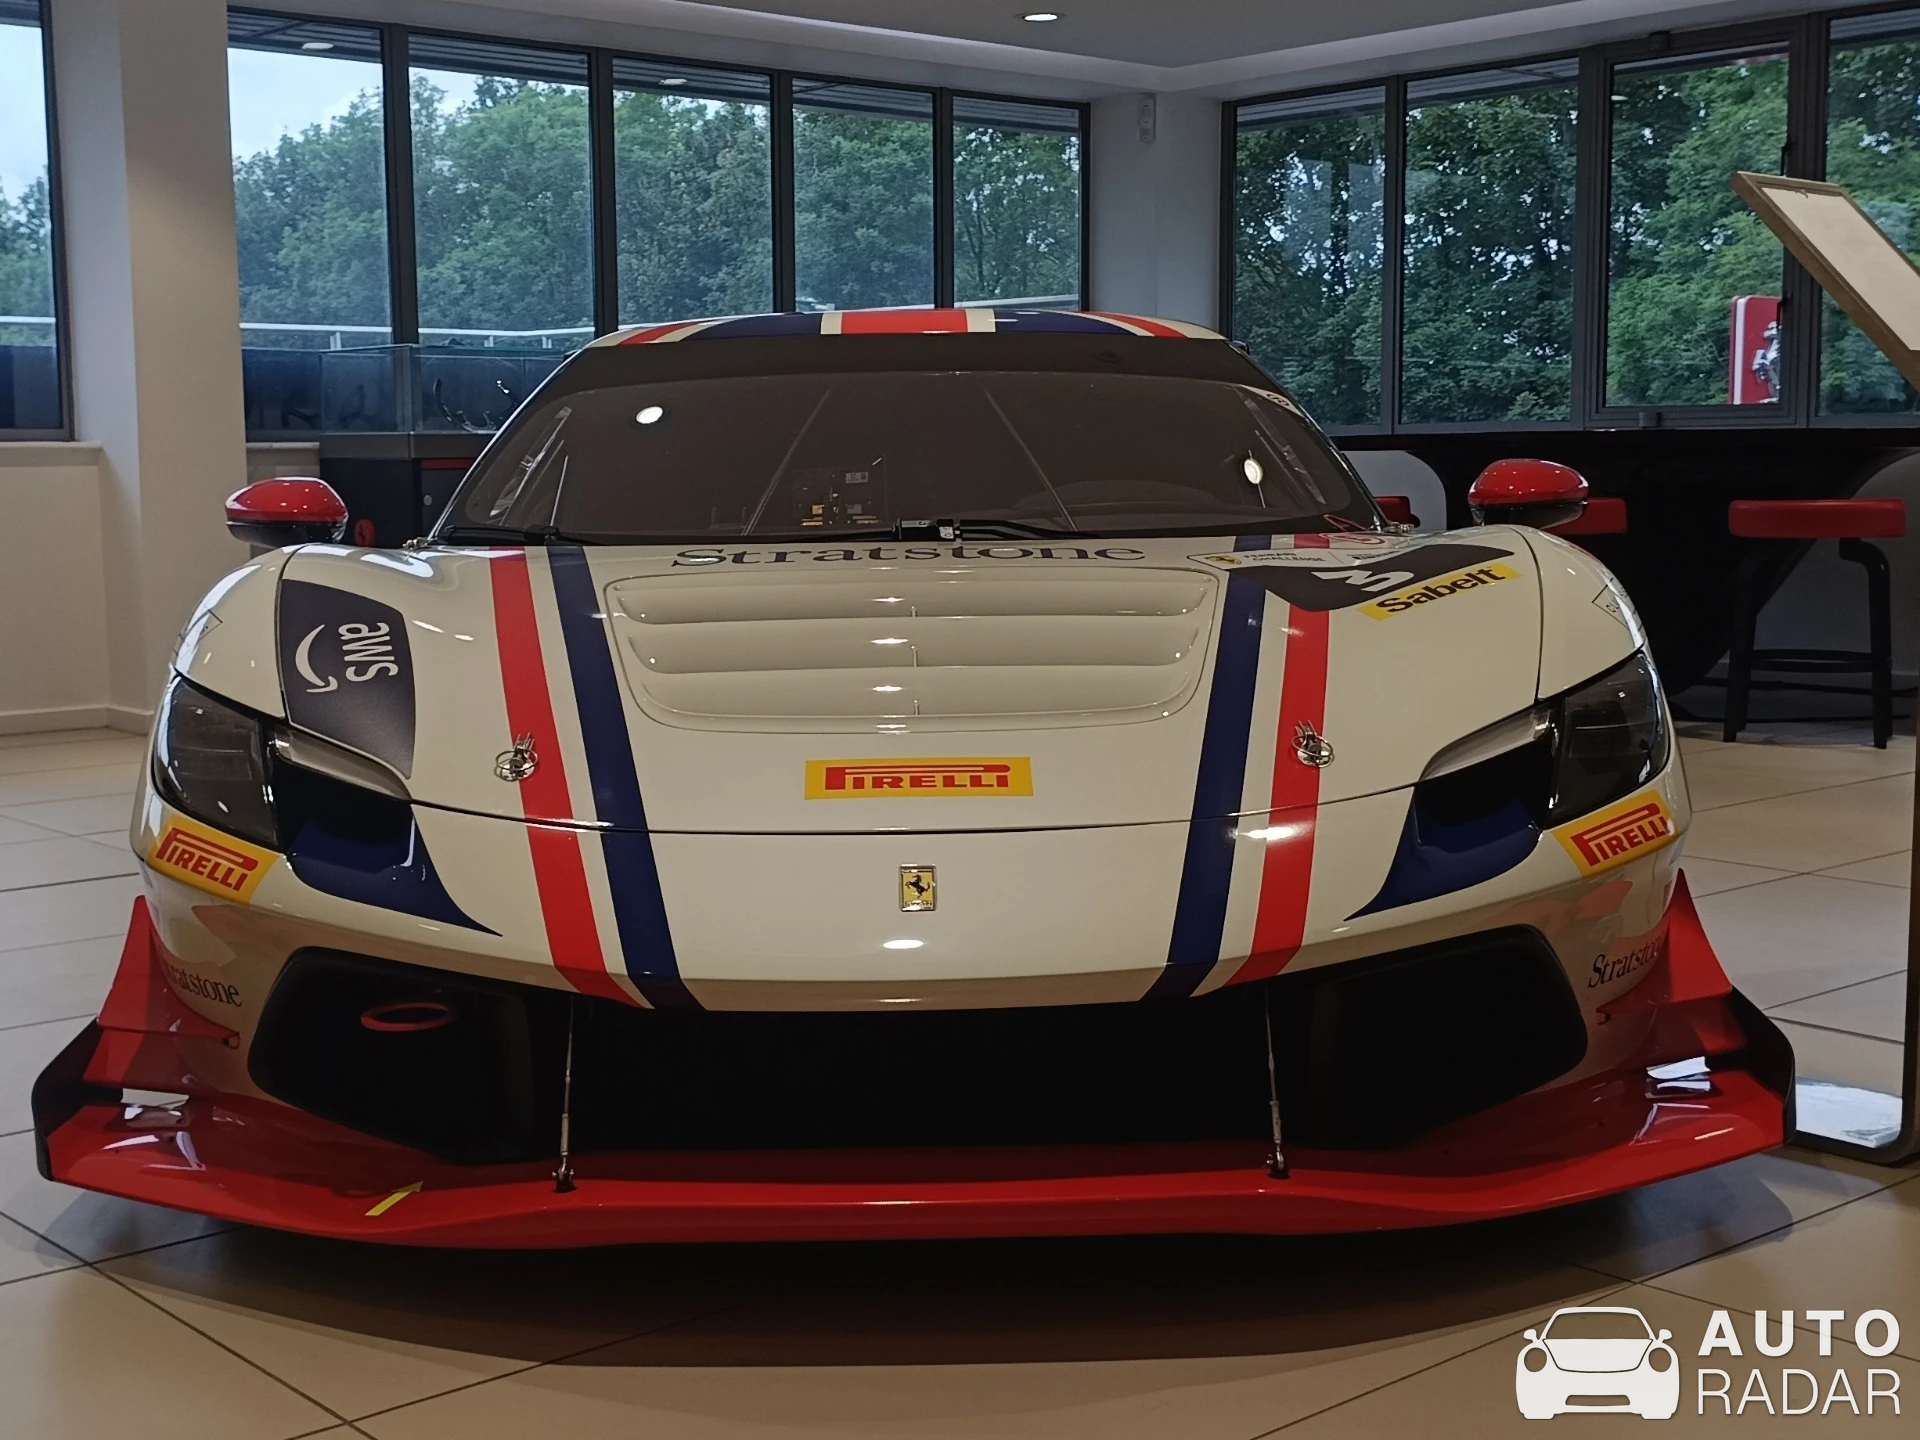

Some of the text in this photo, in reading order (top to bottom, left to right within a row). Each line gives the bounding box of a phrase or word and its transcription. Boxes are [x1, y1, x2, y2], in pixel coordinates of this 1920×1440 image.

[671, 545, 1146, 567] Stratstone
[1375, 566, 1507, 613] Sabelt
[825, 764, 1011, 790] PIRELLI
[1569, 802, 1671, 867] PIRELLI
[155, 827, 259, 891] PIRELLI
